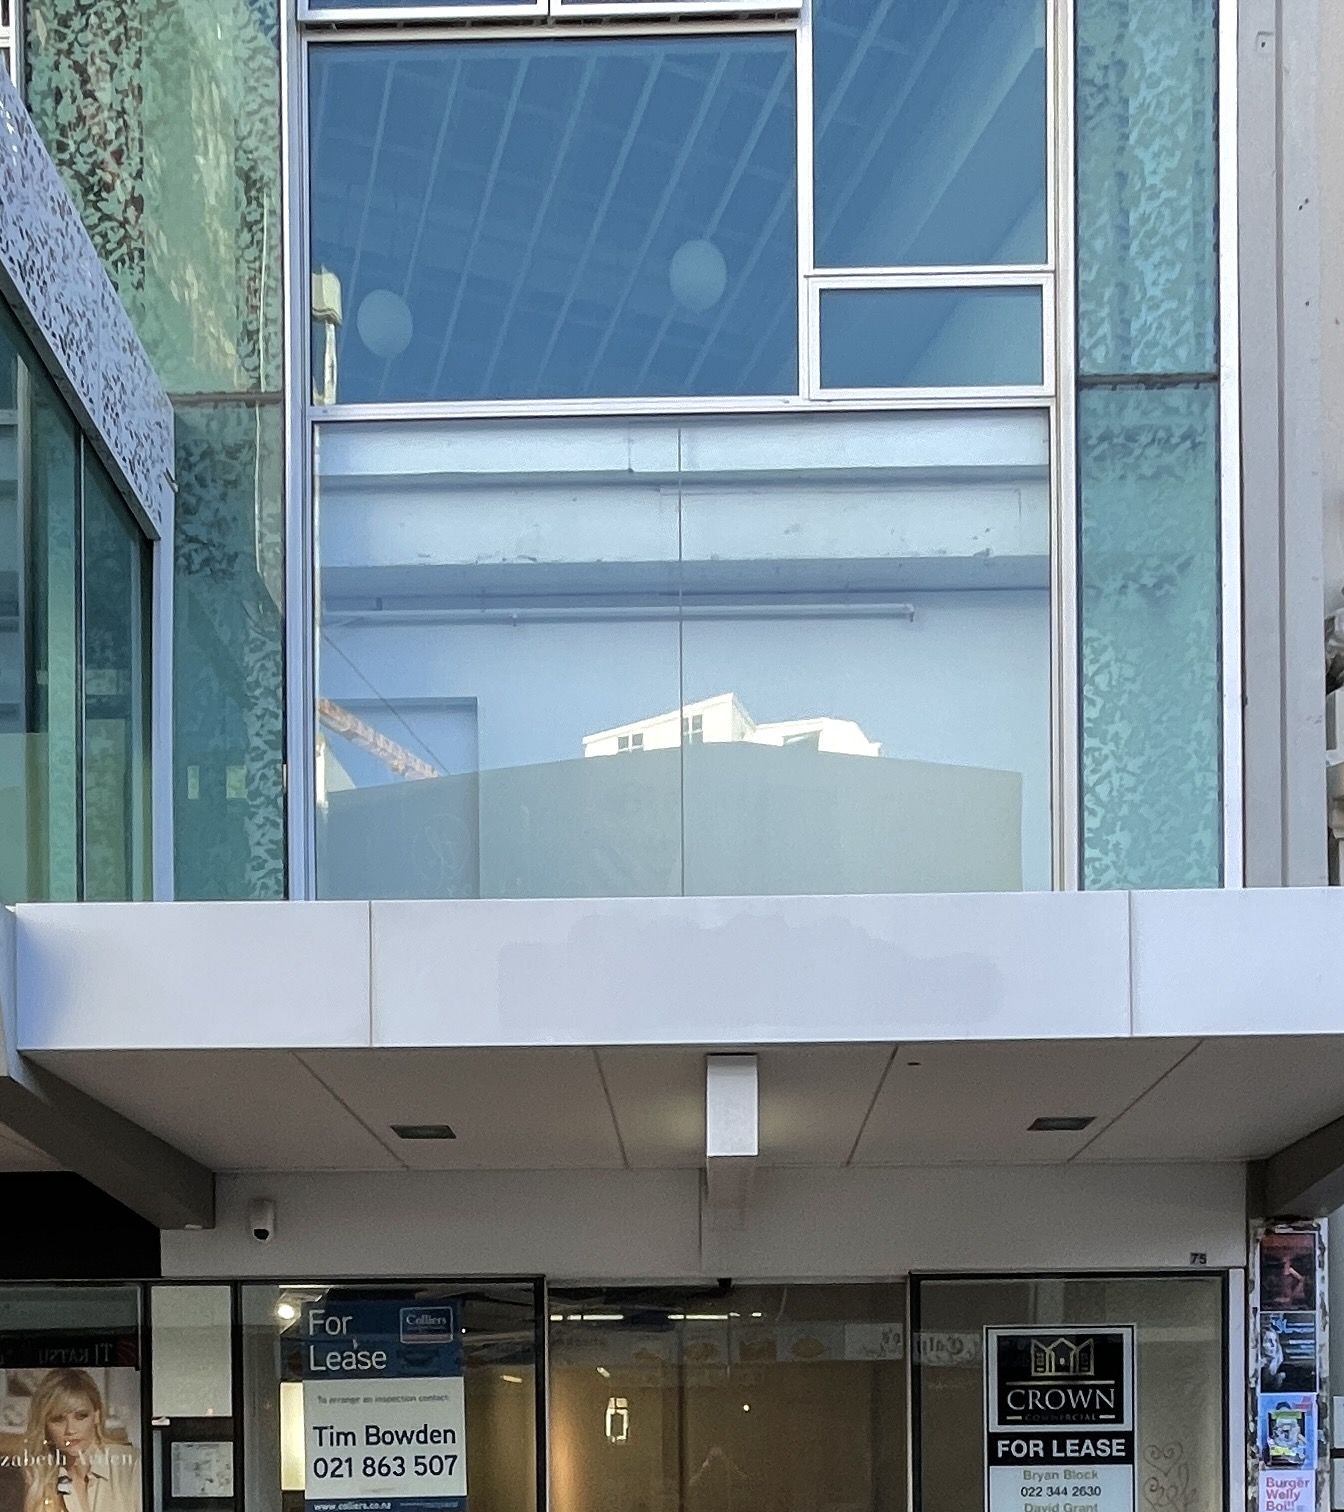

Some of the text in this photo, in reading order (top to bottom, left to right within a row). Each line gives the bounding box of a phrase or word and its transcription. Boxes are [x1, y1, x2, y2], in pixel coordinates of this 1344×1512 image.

[1190, 1252, 1207, 1264] 75
[308, 1309, 447, 1336] For Colliers
[309, 1344, 387, 1371] Lease
[1007, 1388, 1115, 1411] CROWN
[312, 1424, 457, 1447] Tim Bowden
[997, 1438, 1127, 1458] FOR LEASE
[313, 1454, 458, 1478] 021 863 507
[1023, 1469, 1099, 1483] Bryan Block
[1020, 1486, 1102, 1497] 022 344 2630
[1266, 1489, 1301, 1502] Welly
